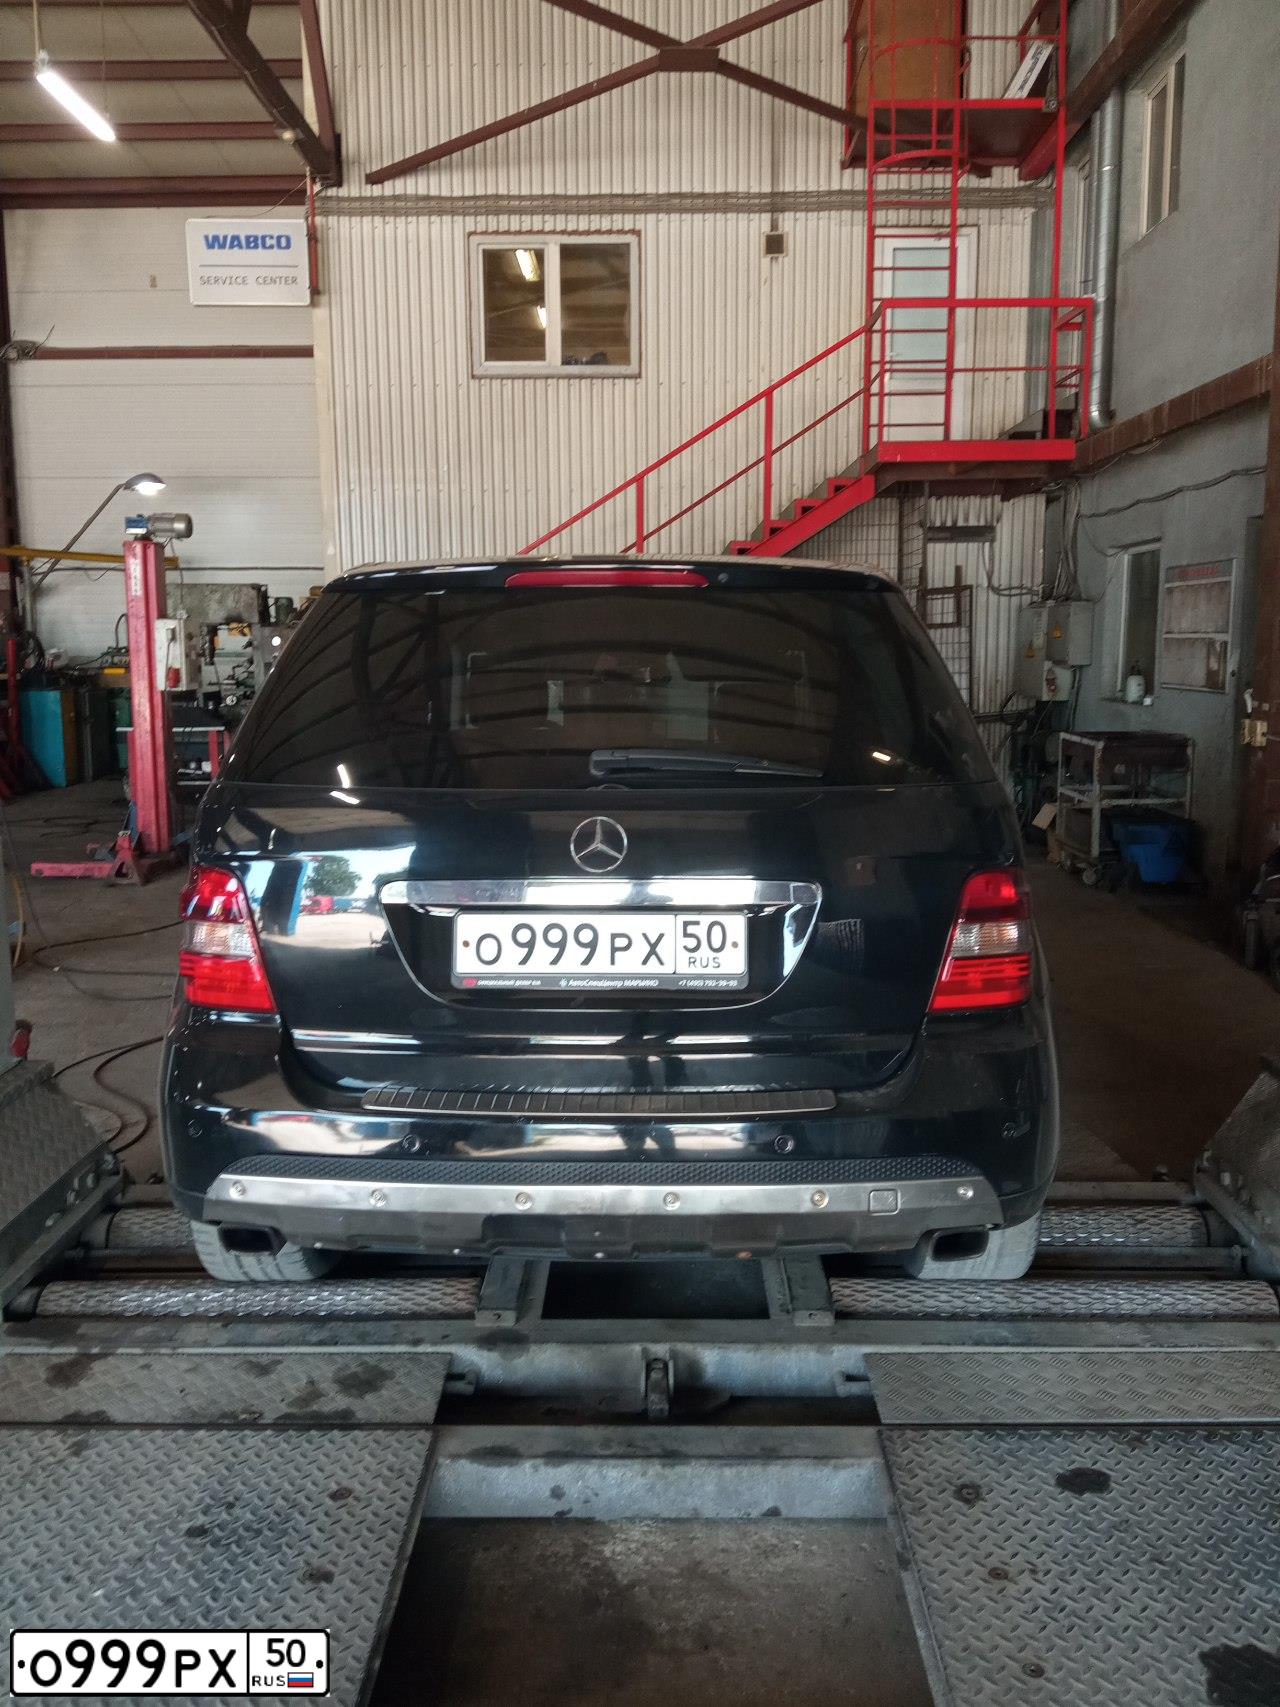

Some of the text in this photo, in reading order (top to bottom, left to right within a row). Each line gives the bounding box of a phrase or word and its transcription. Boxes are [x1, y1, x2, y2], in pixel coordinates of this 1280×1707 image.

[204, 234, 292, 250] WABCO
[200, 275, 298, 286] SERVICE CENTER
[682, 920, 727, 953] 50
[688, 956, 721, 969] RUS
